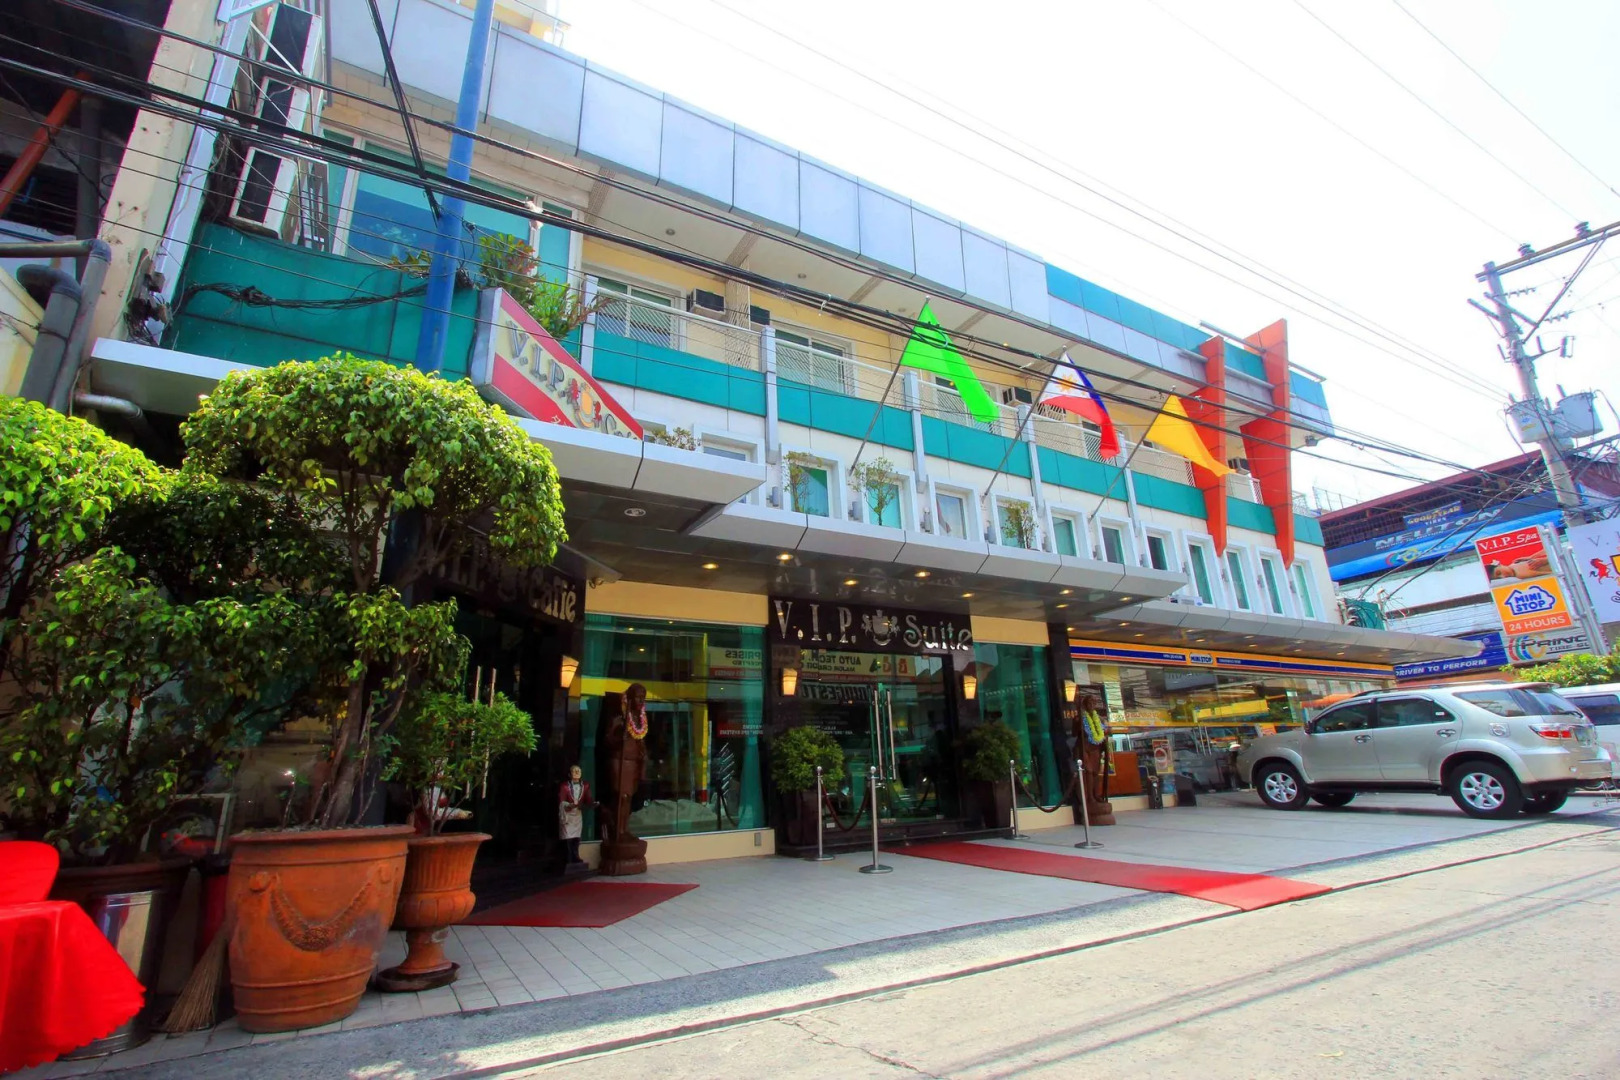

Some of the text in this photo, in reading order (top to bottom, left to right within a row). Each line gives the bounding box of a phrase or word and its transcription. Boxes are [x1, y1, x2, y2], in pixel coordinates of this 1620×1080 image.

[1479, 536, 1515, 551] V.I.P.
[1516, 533, 1538, 543] Spa
[1514, 592, 1542, 604] MINI
[1515, 600, 1546, 612] STOP
[773, 599, 972, 651] V.I.P. Suite
[1509, 615, 1565, 632] 24 HOURS
[1442, 659, 1487, 670] PERFORM
